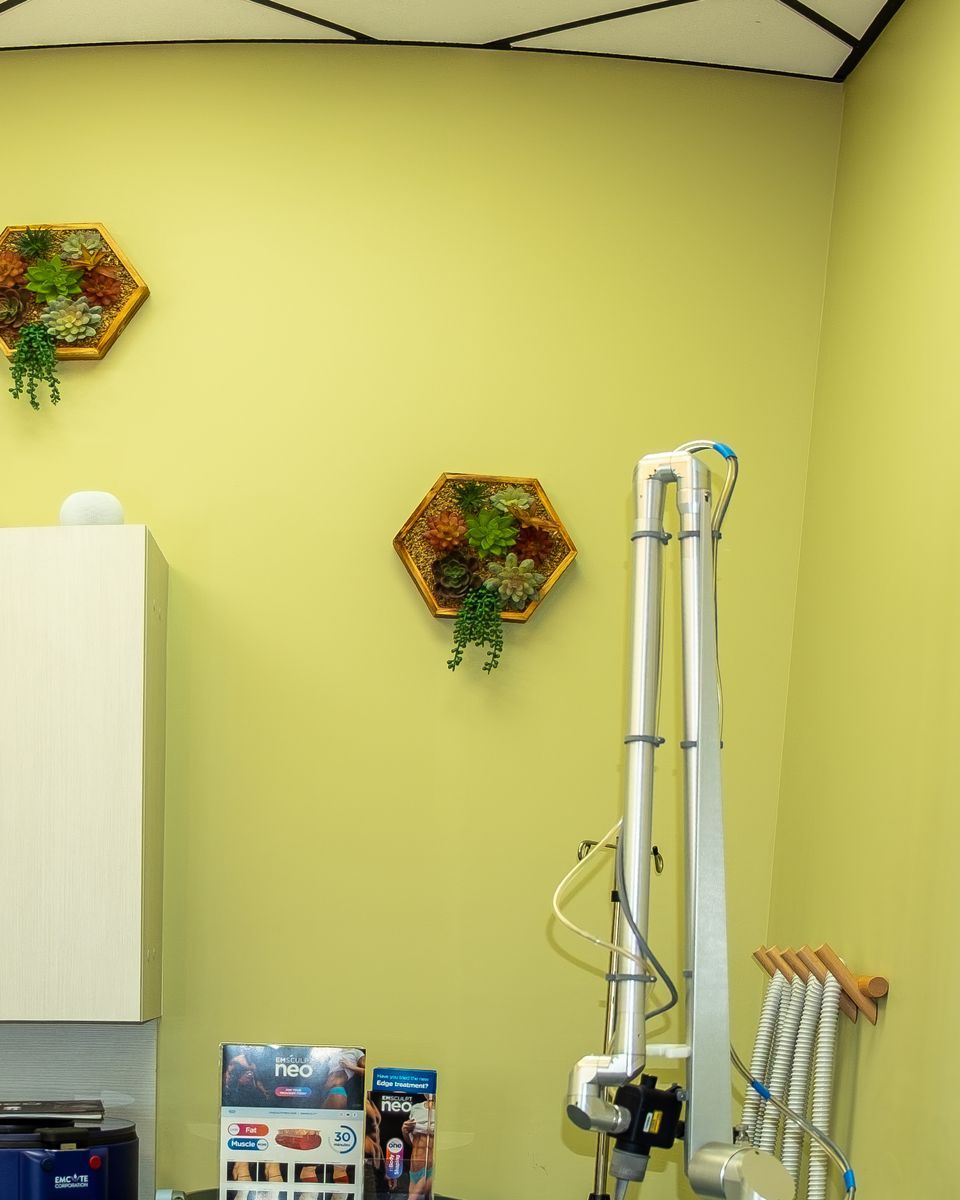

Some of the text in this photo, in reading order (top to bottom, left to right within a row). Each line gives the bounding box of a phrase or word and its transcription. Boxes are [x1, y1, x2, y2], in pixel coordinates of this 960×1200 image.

[275, 1064, 313, 1078] neo
[394, 1081, 429, 1089] treatment?
[381, 1100, 412, 1112] neo
[334, 1132, 350, 1142] 30
[231, 1140, 255, 1148] Muscle
